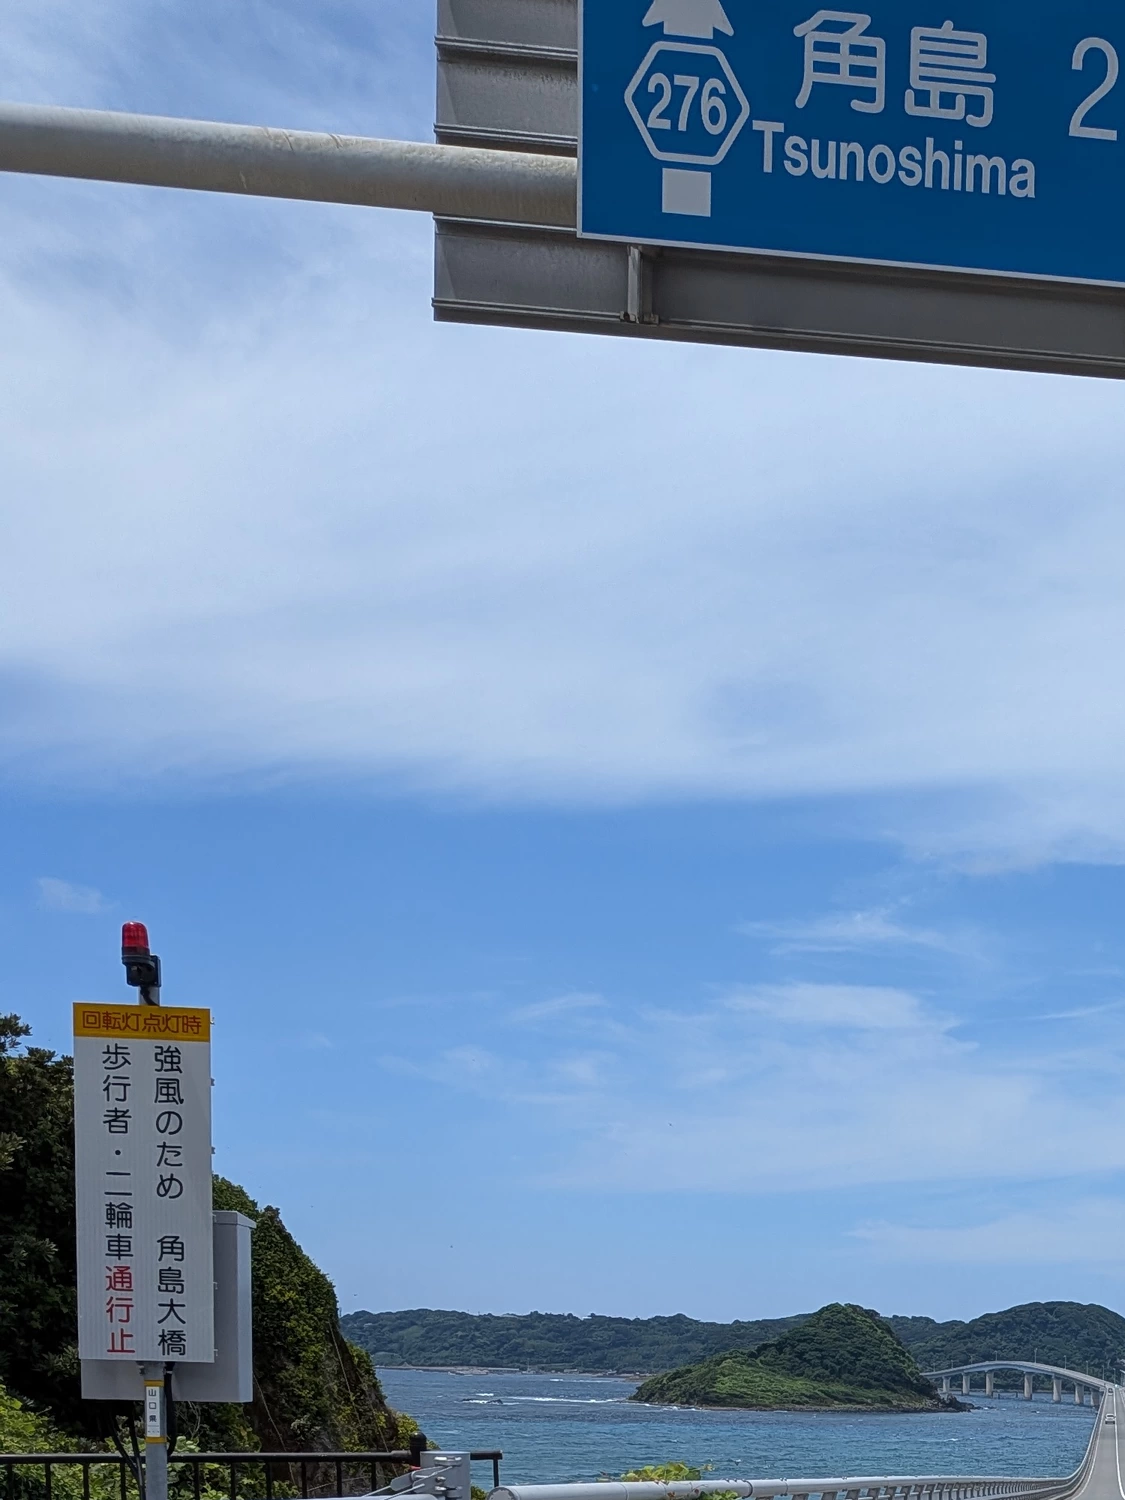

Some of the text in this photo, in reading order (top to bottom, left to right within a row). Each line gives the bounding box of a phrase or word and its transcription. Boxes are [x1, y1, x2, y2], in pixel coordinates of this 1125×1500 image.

[794, 9, 995, 129] 角島
[645, 73, 729, 135] 276
[751, 119, 1037, 200] Tsunoshima
[82, 1011, 203, 1035] 回転灯点灯時
[147, 1388, 157, 1423] 山口県
